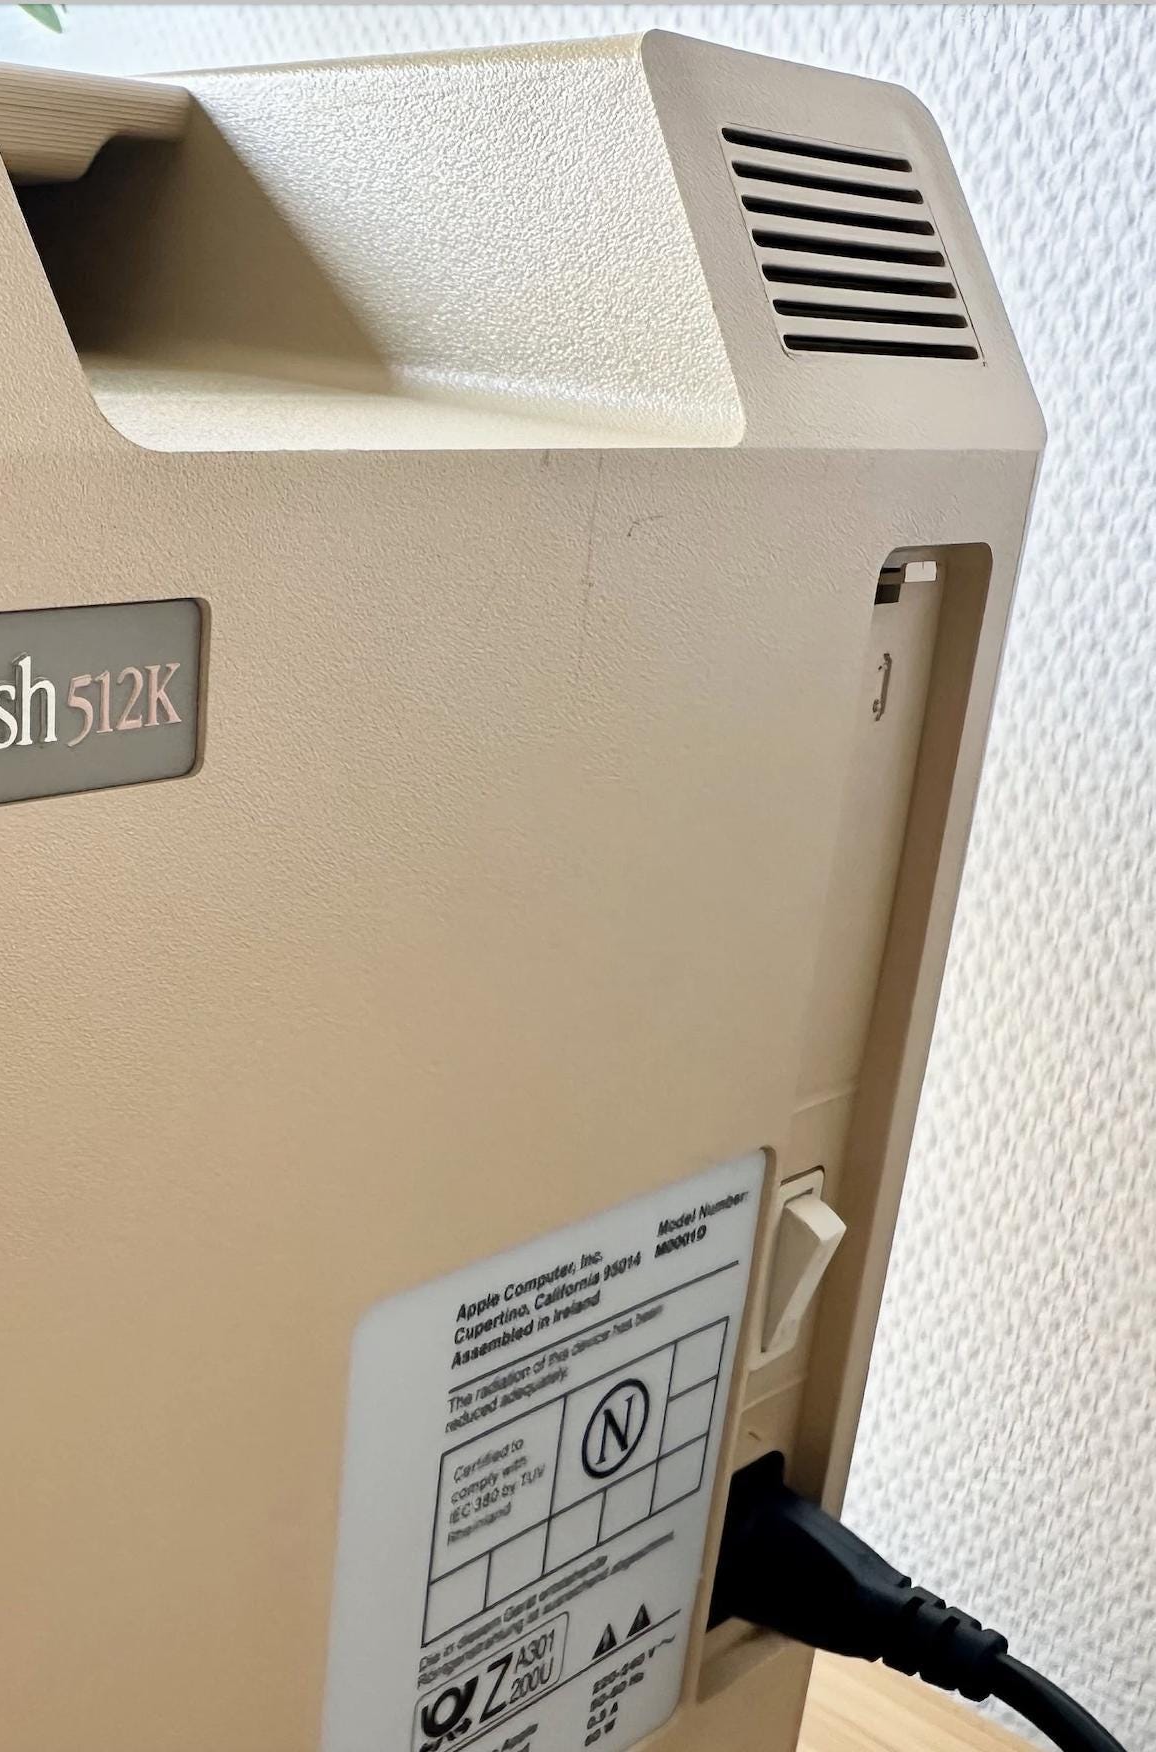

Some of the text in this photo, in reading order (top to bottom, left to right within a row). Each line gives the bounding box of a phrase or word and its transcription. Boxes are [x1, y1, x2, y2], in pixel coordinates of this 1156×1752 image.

[67, 662, 182, 747] 512K
[656, 1207, 696, 1238] Model
[456, 1292, 500, 1322] Apple
[504, 1260, 576, 1301] Computer,
[534, 1271, 601, 1310] California
[603, 1251, 642, 1282] 95014
[451, 1289, 601, 1370] Assembled in Ireland
[447, 1392, 473, 1414] The
[595, 1394, 635, 1465] N
[479, 1651, 514, 1724] Z
